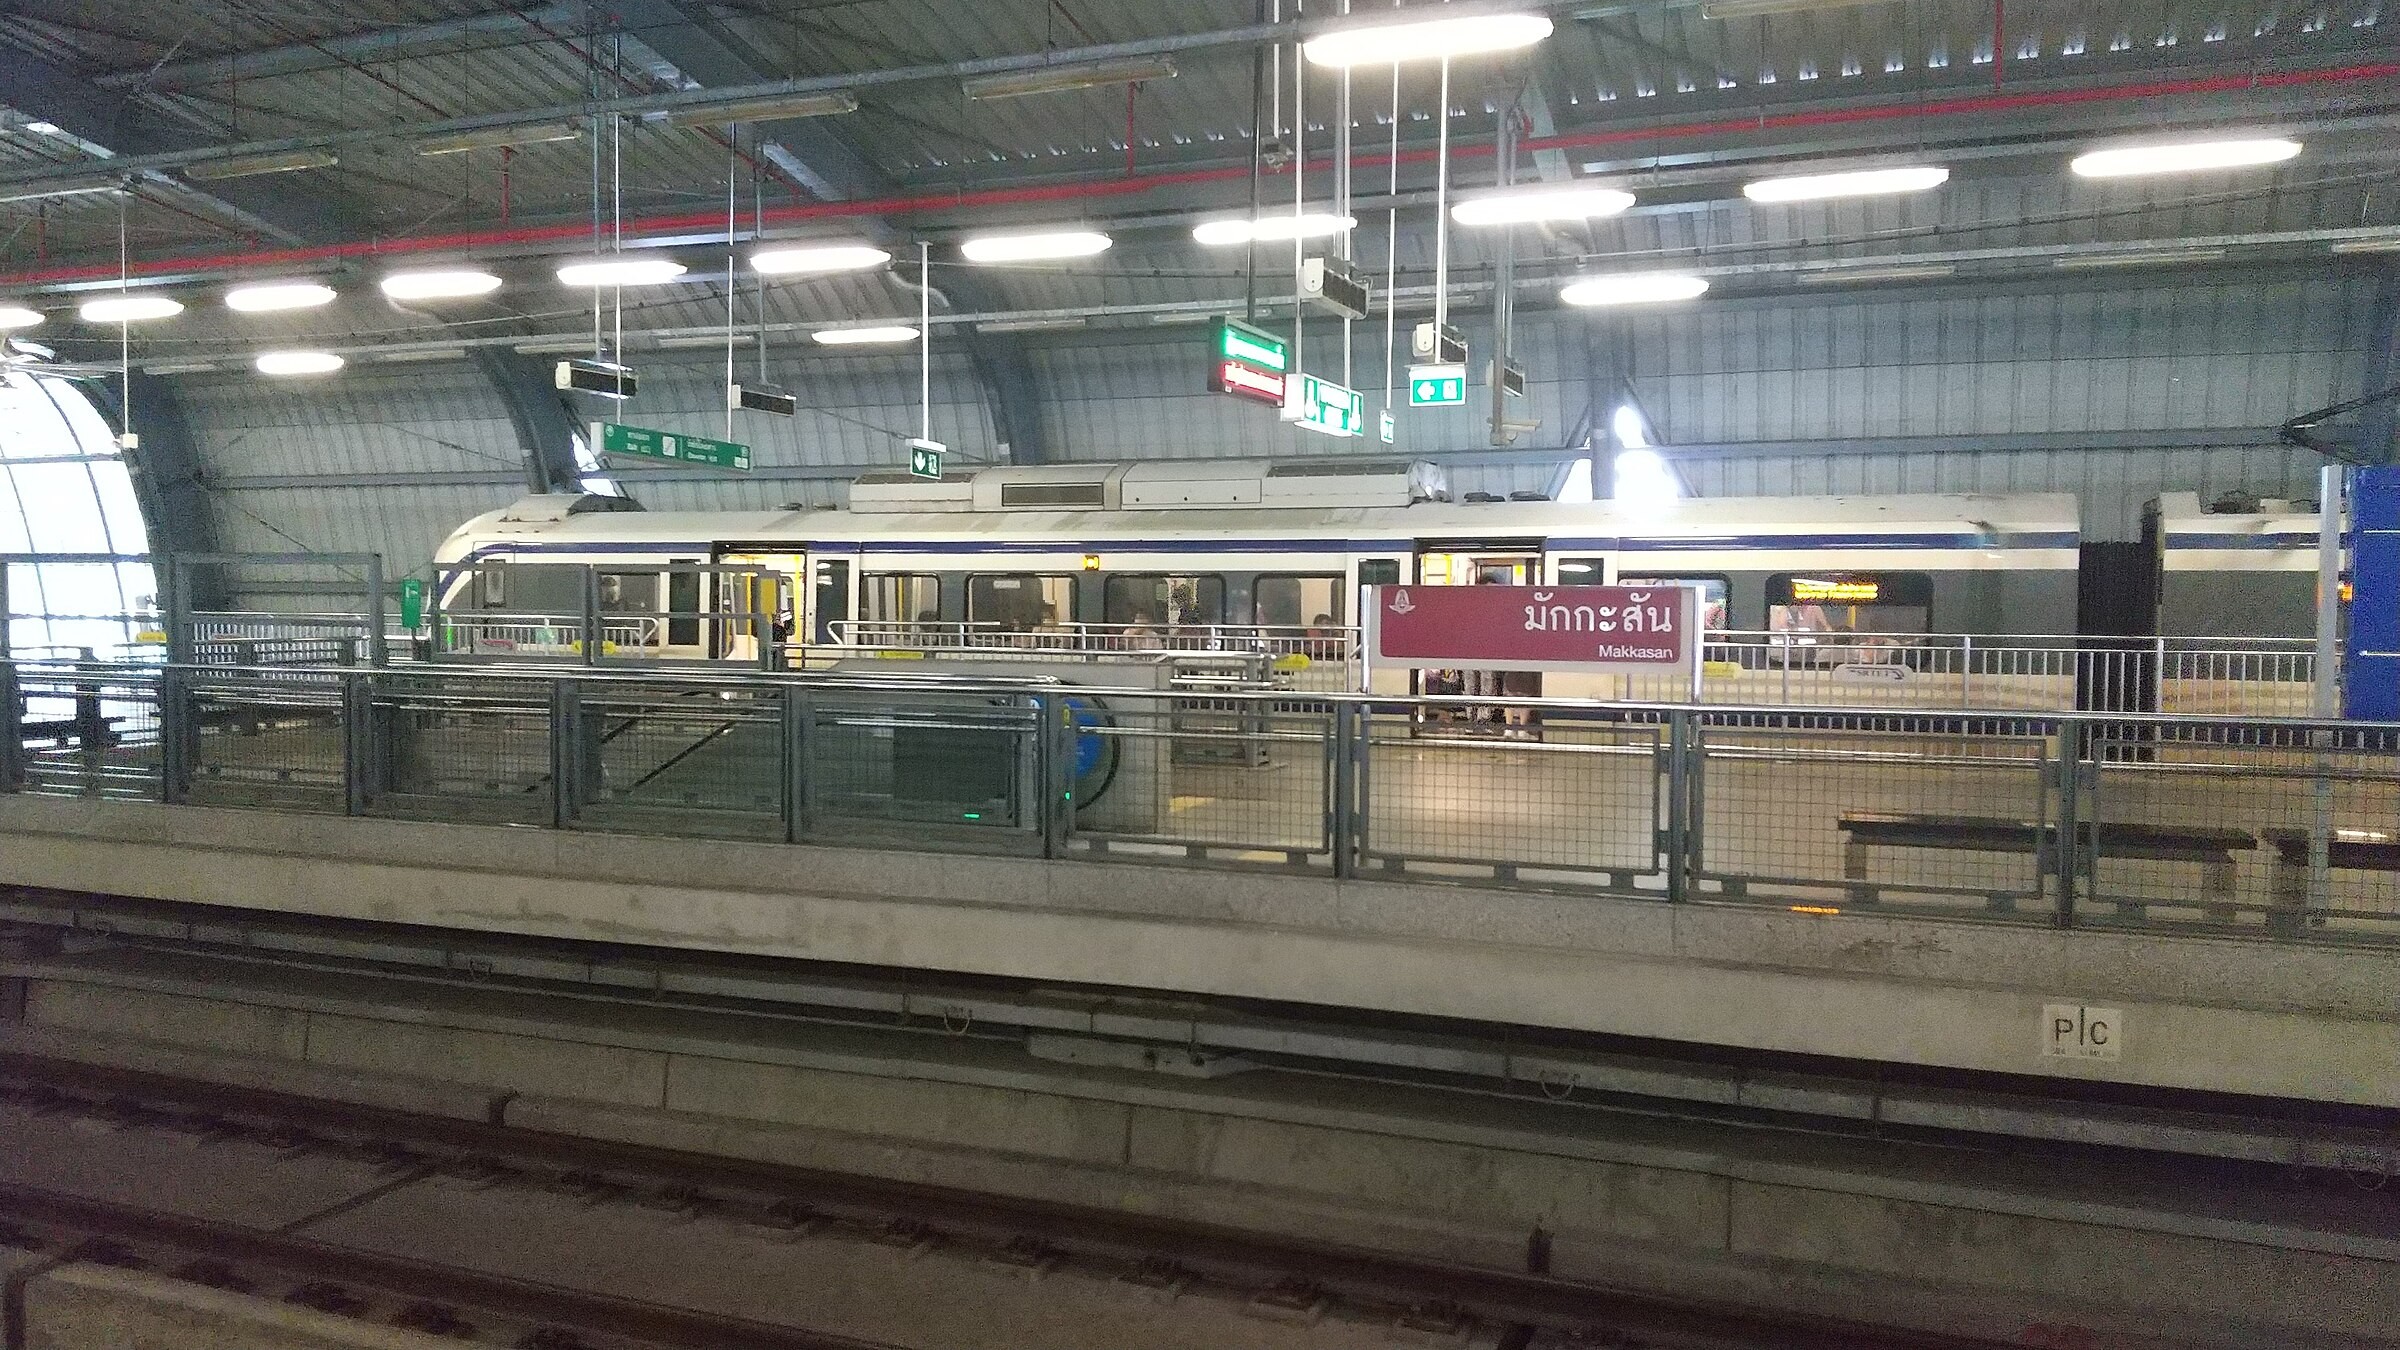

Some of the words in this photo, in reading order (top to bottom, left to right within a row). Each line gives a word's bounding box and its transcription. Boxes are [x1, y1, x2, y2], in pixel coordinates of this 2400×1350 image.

[1524, 592, 1672, 633] มักกะสัน
[1598, 644, 1673, 660] Makkasan
